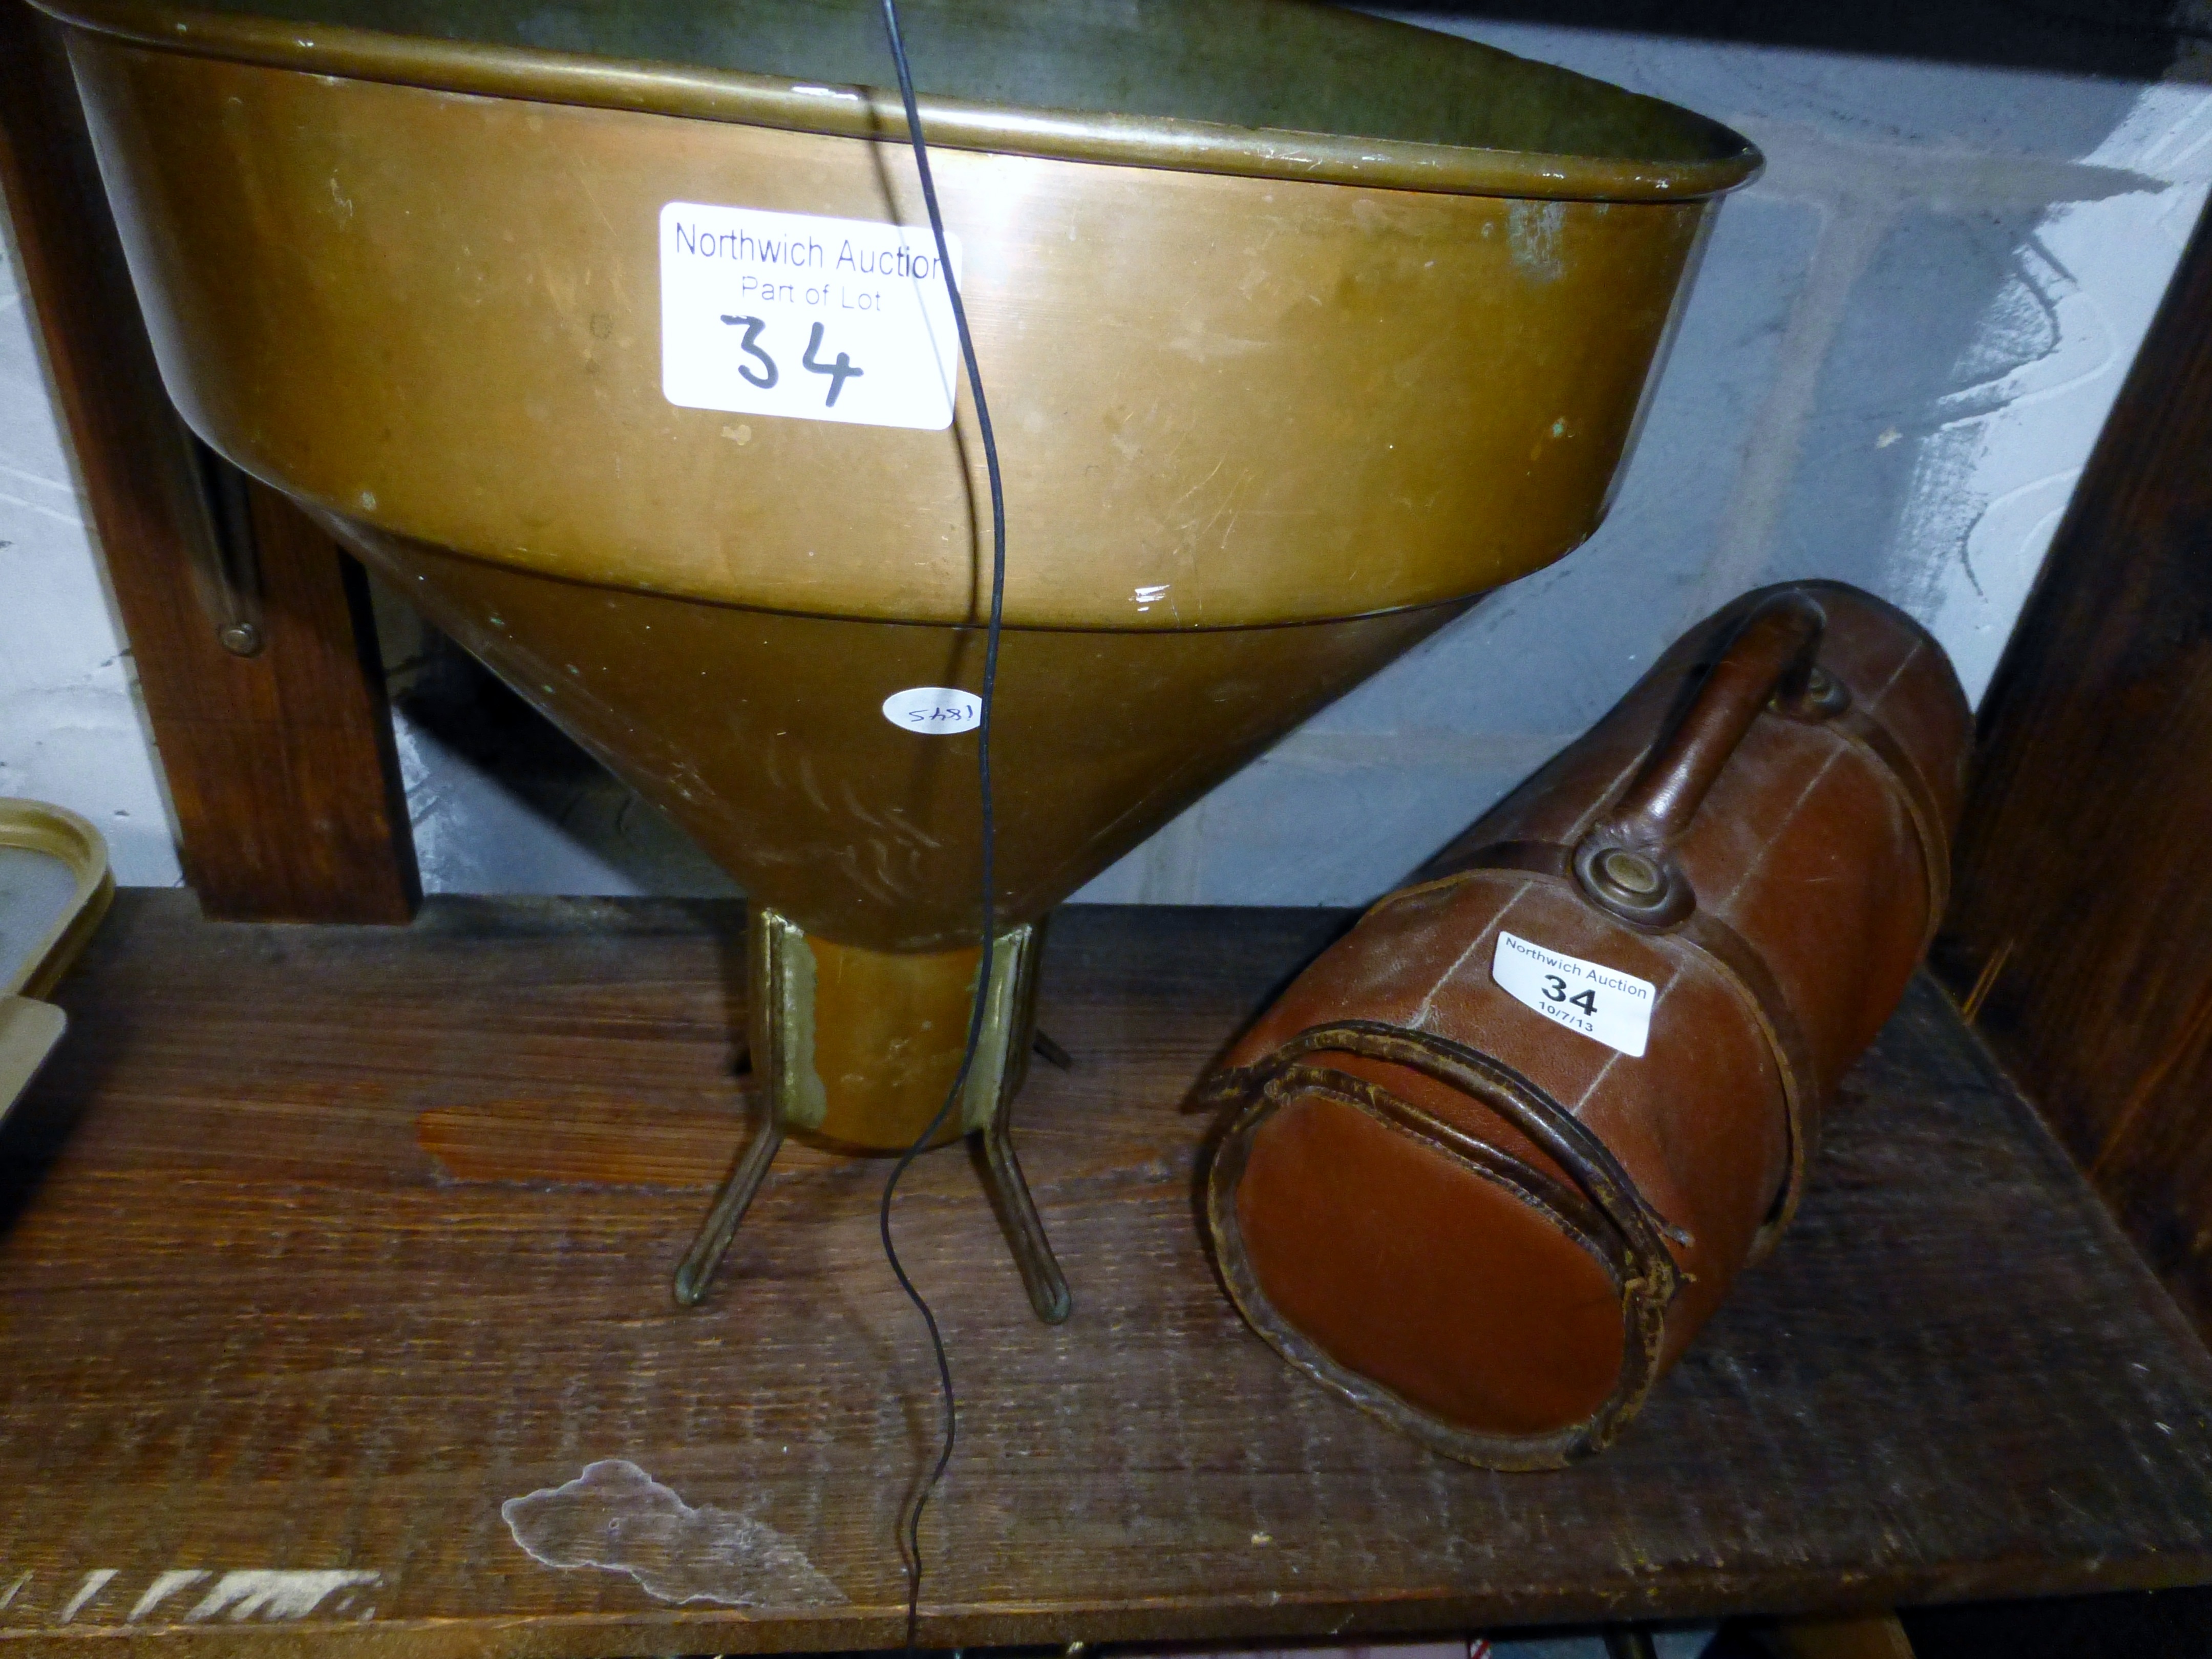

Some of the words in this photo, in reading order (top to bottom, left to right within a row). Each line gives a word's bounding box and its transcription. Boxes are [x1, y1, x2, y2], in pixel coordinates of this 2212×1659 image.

[676, 222, 823, 268] Northwich
[742, 275, 794, 303] Part
[805, 284, 830, 306] of
[842, 286, 881, 311] Lot
[720, 314, 864, 408] 34
[1505, 937, 1581, 975] Northwich
[1586, 969, 1647, 999] Auction
[1538, 1001, 1593, 1032] 10/7/13
[1541, 974, 1598, 1016] 34
